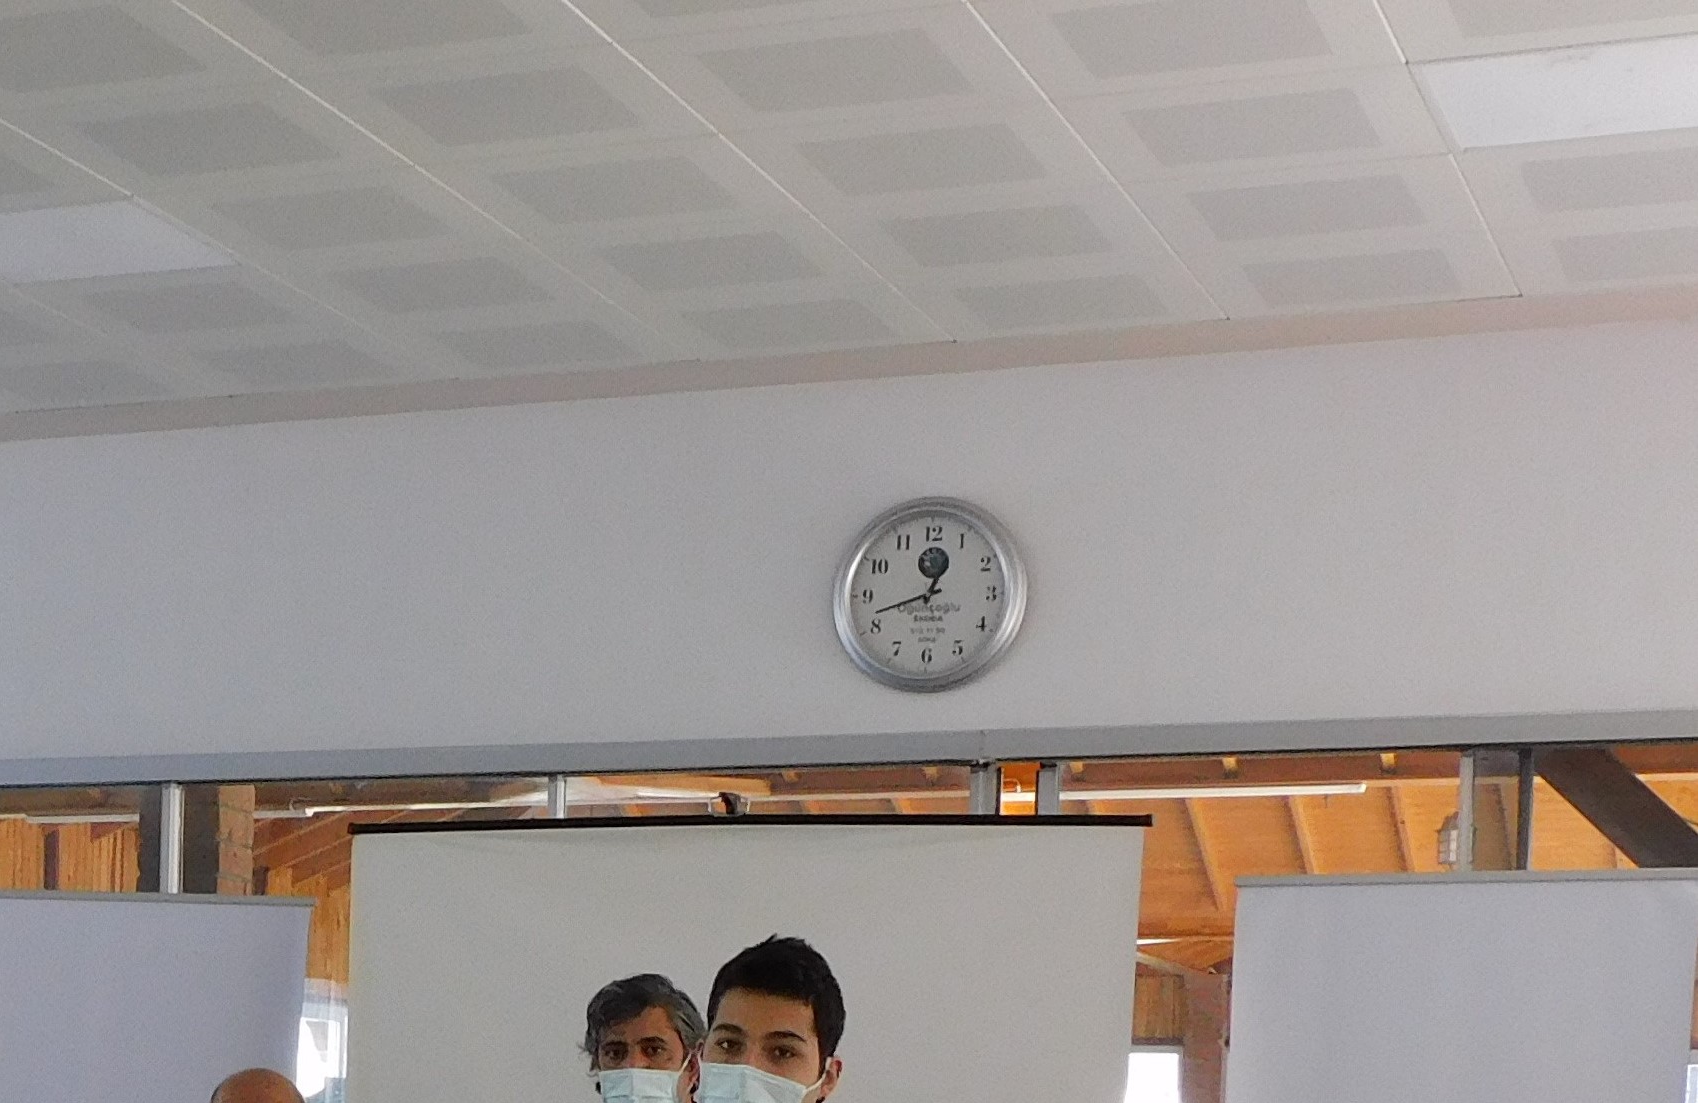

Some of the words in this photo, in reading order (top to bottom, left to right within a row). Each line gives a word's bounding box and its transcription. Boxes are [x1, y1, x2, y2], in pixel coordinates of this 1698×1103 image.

[926, 526, 942, 542] 12
[960, 533, 964, 549] 1
[897, 534, 910, 550] 11
[872, 559, 888, 574] 10
[981, 556, 991, 571] 2
[862, 588, 873, 603] 9
[986, 585, 997, 601] 3
[871, 618, 881, 634] 8
[976, 616, 986, 632] 4
[892, 641, 901, 656] 7
[952, 640, 963, 655] 5
[921, 648, 932, 663] 6
